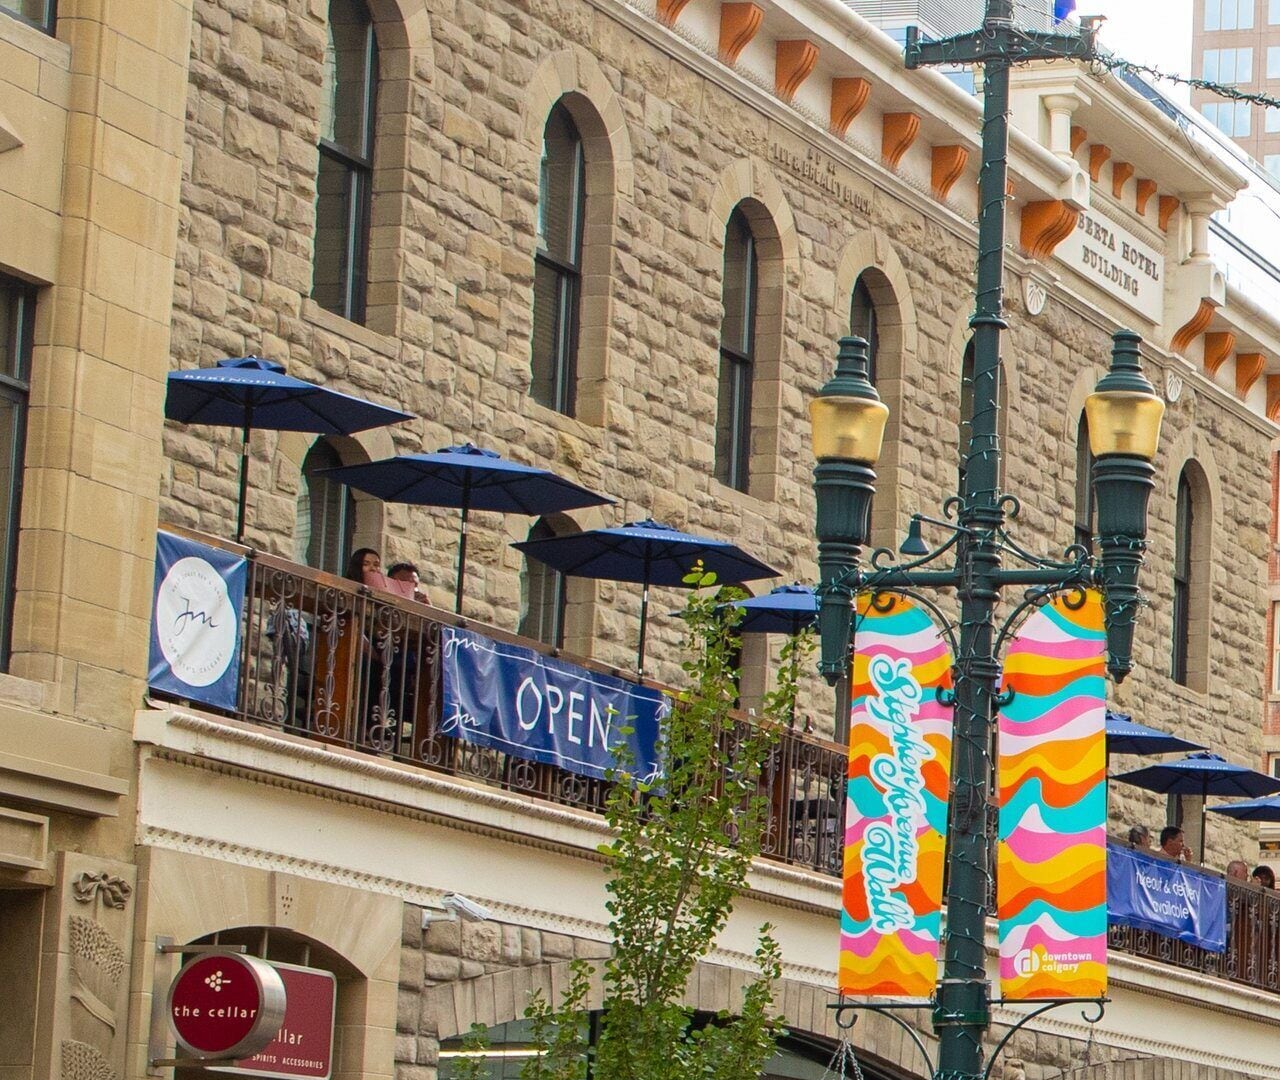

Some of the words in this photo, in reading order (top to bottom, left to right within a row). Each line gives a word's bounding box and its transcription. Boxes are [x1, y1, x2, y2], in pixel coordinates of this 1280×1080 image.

[1078, 212, 1115, 252] BERTA
[1122, 241, 1159, 281] HOTEL
[1082, 245, 1139, 296] BUILDING
[516, 676, 613, 752] OPEN
[869, 658, 930, 790] Stephen
[873, 756, 923, 880] Avenue
[865, 826, 911, 930] Walk
[1163, 880, 1171, 894] &
[1042, 952, 1092, 962] downtown
[1042, 962, 1079, 974] calgary
[174, 1005, 200, 1018] the
[208, 1006, 257, 1019] cellar
[272, 1029, 303, 1045] llar
[282, 1056, 324, 1070] ACCESSORIES
